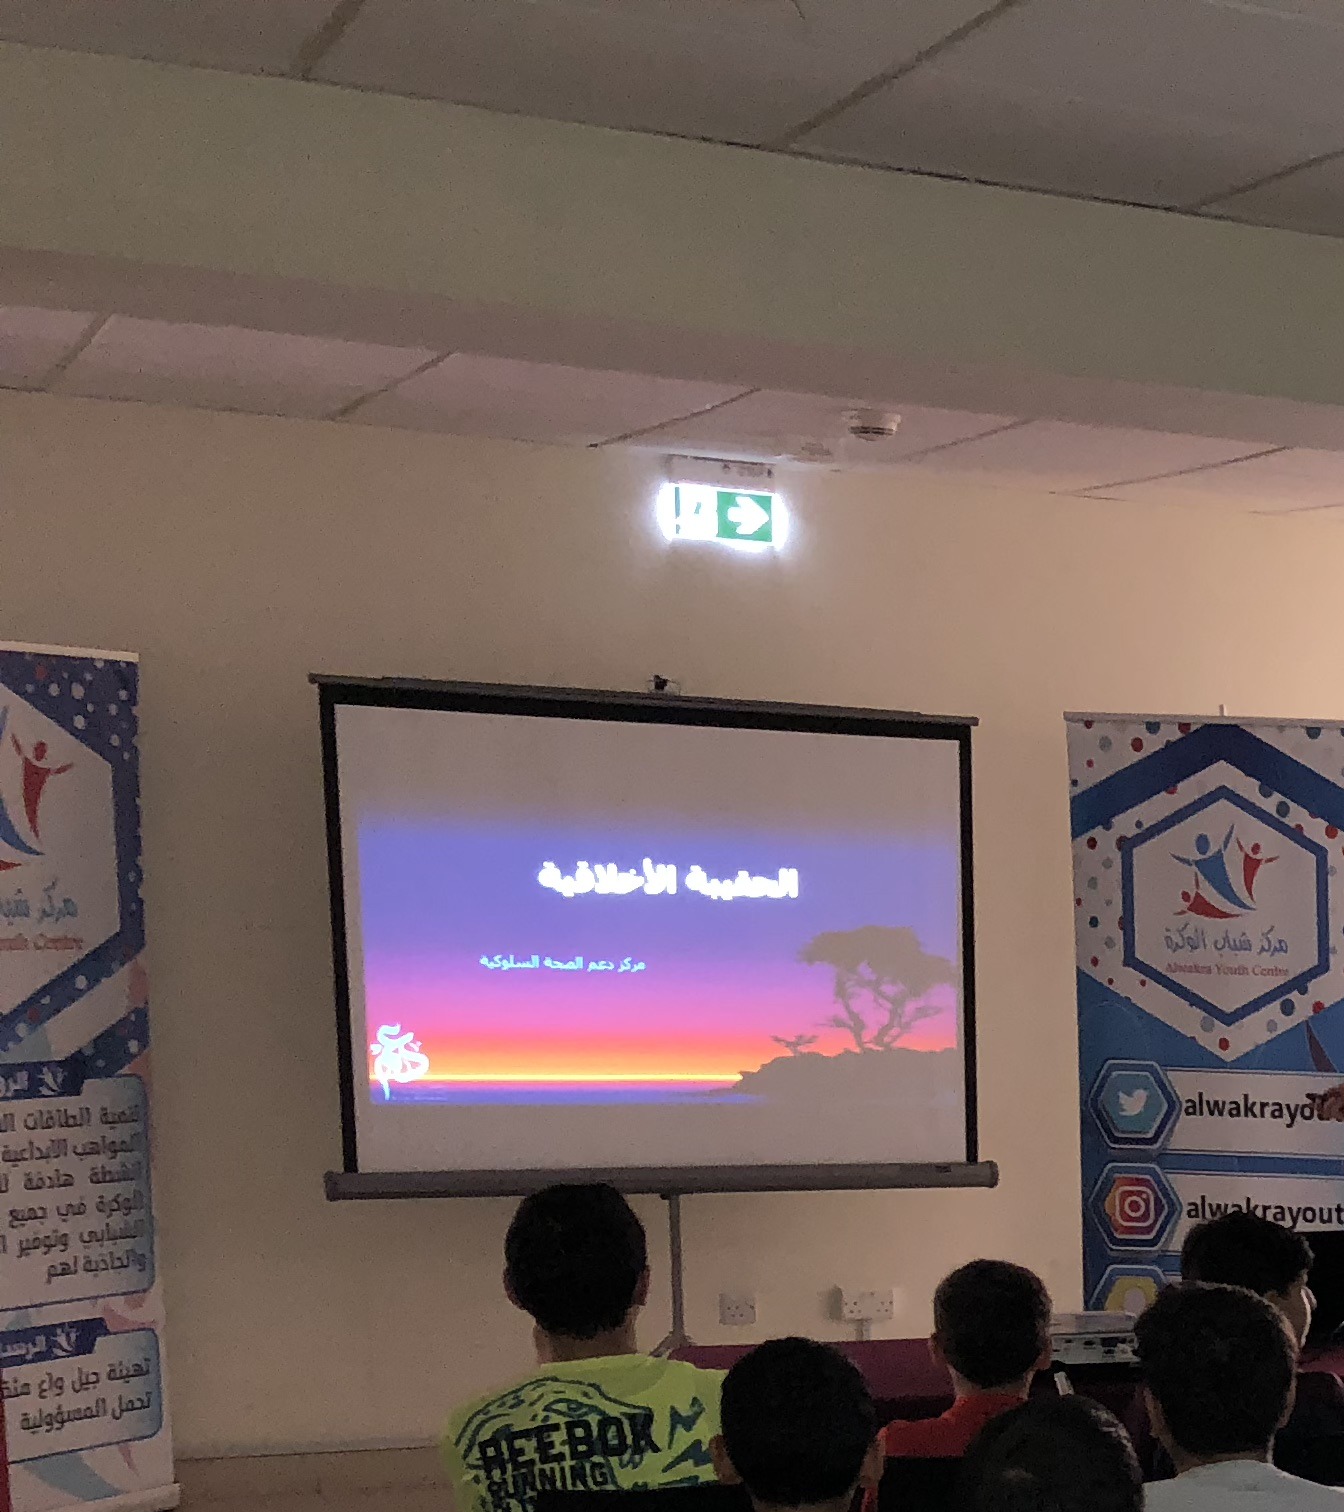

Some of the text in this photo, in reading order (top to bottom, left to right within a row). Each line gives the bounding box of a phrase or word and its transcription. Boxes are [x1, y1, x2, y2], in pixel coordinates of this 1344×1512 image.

[538, 857, 677, 897] الأخلاقية
[1164, 921, 1289, 957] مركز شباب الوكرة
[479, 955, 646, 972] مركز دعم الصحة السلوكية
[1216, 964, 1248, 976] Youth
[23, 1106, 91, 1131] الطاقات
[24, 1168, 75, 1191] هادفة
[9, 1205, 48, 1229] جميع
[56, 1195, 87, 1223] في
[71, 1366, 100, 1394] جيل
[20, 1391, 152, 1435] تحمل المسؤولية
[478, 1411, 662, 1482] REEBOK
